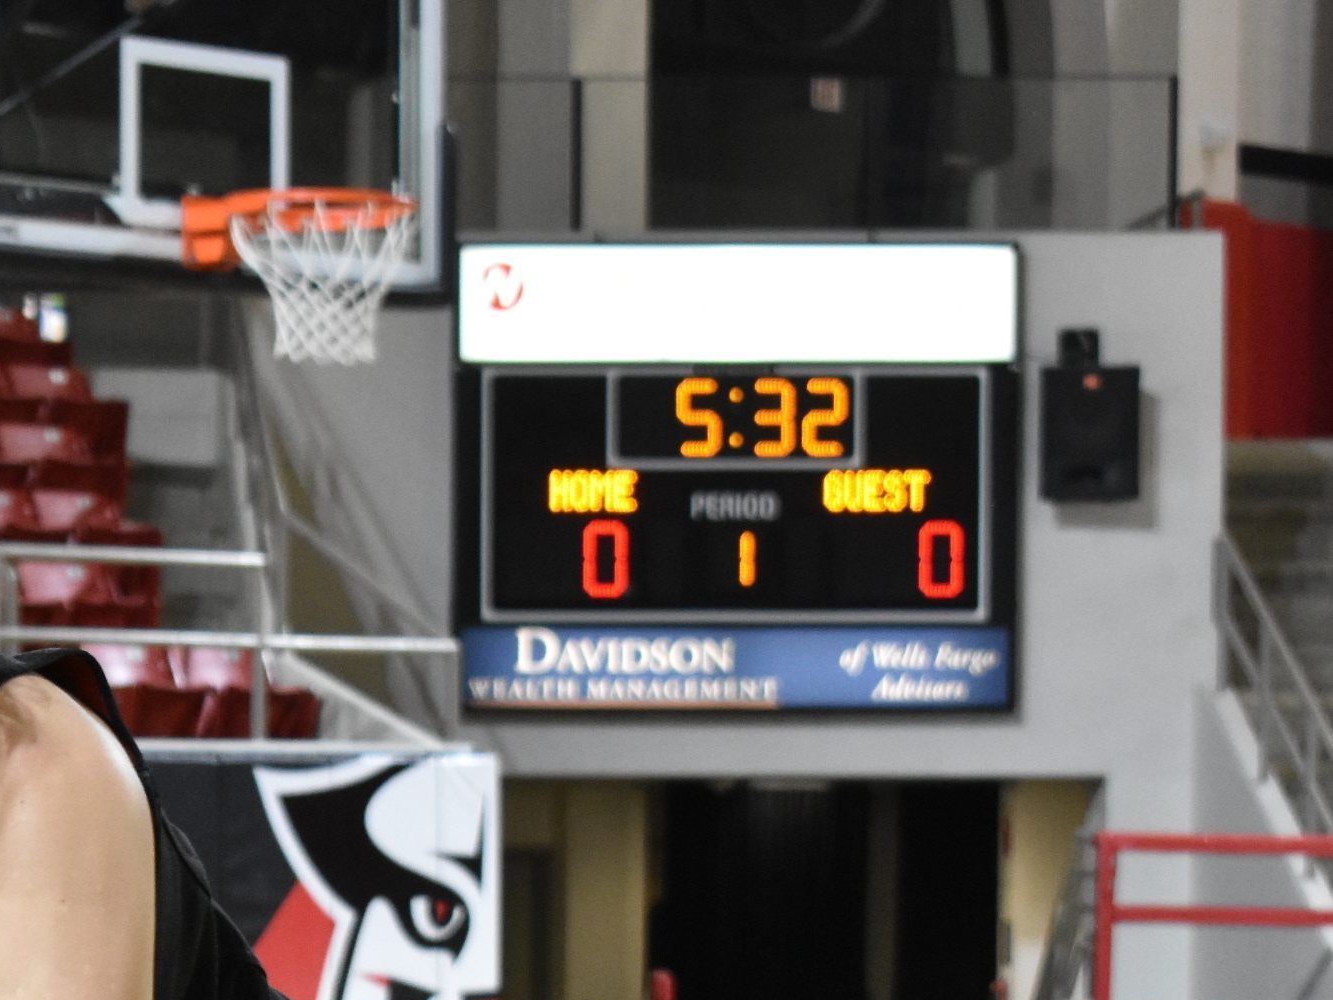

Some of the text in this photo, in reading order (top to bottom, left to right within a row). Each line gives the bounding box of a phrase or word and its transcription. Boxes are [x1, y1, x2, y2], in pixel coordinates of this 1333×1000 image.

[676, 377, 849, 458] 5:32
[548, 469, 638, 513] HOME
[690, 490, 780, 521] PERIOD
[823, 469, 931, 513] GUEST
[582, 519, 629, 599] 0
[738, 530, 756, 587] 1
[917, 519, 965, 599] 0
[515, 626, 735, 675] DAVIDSON
[839, 639, 999, 677] of Wells Fargo
[468, 677, 776, 701] WEALTH MANAGEMENT
